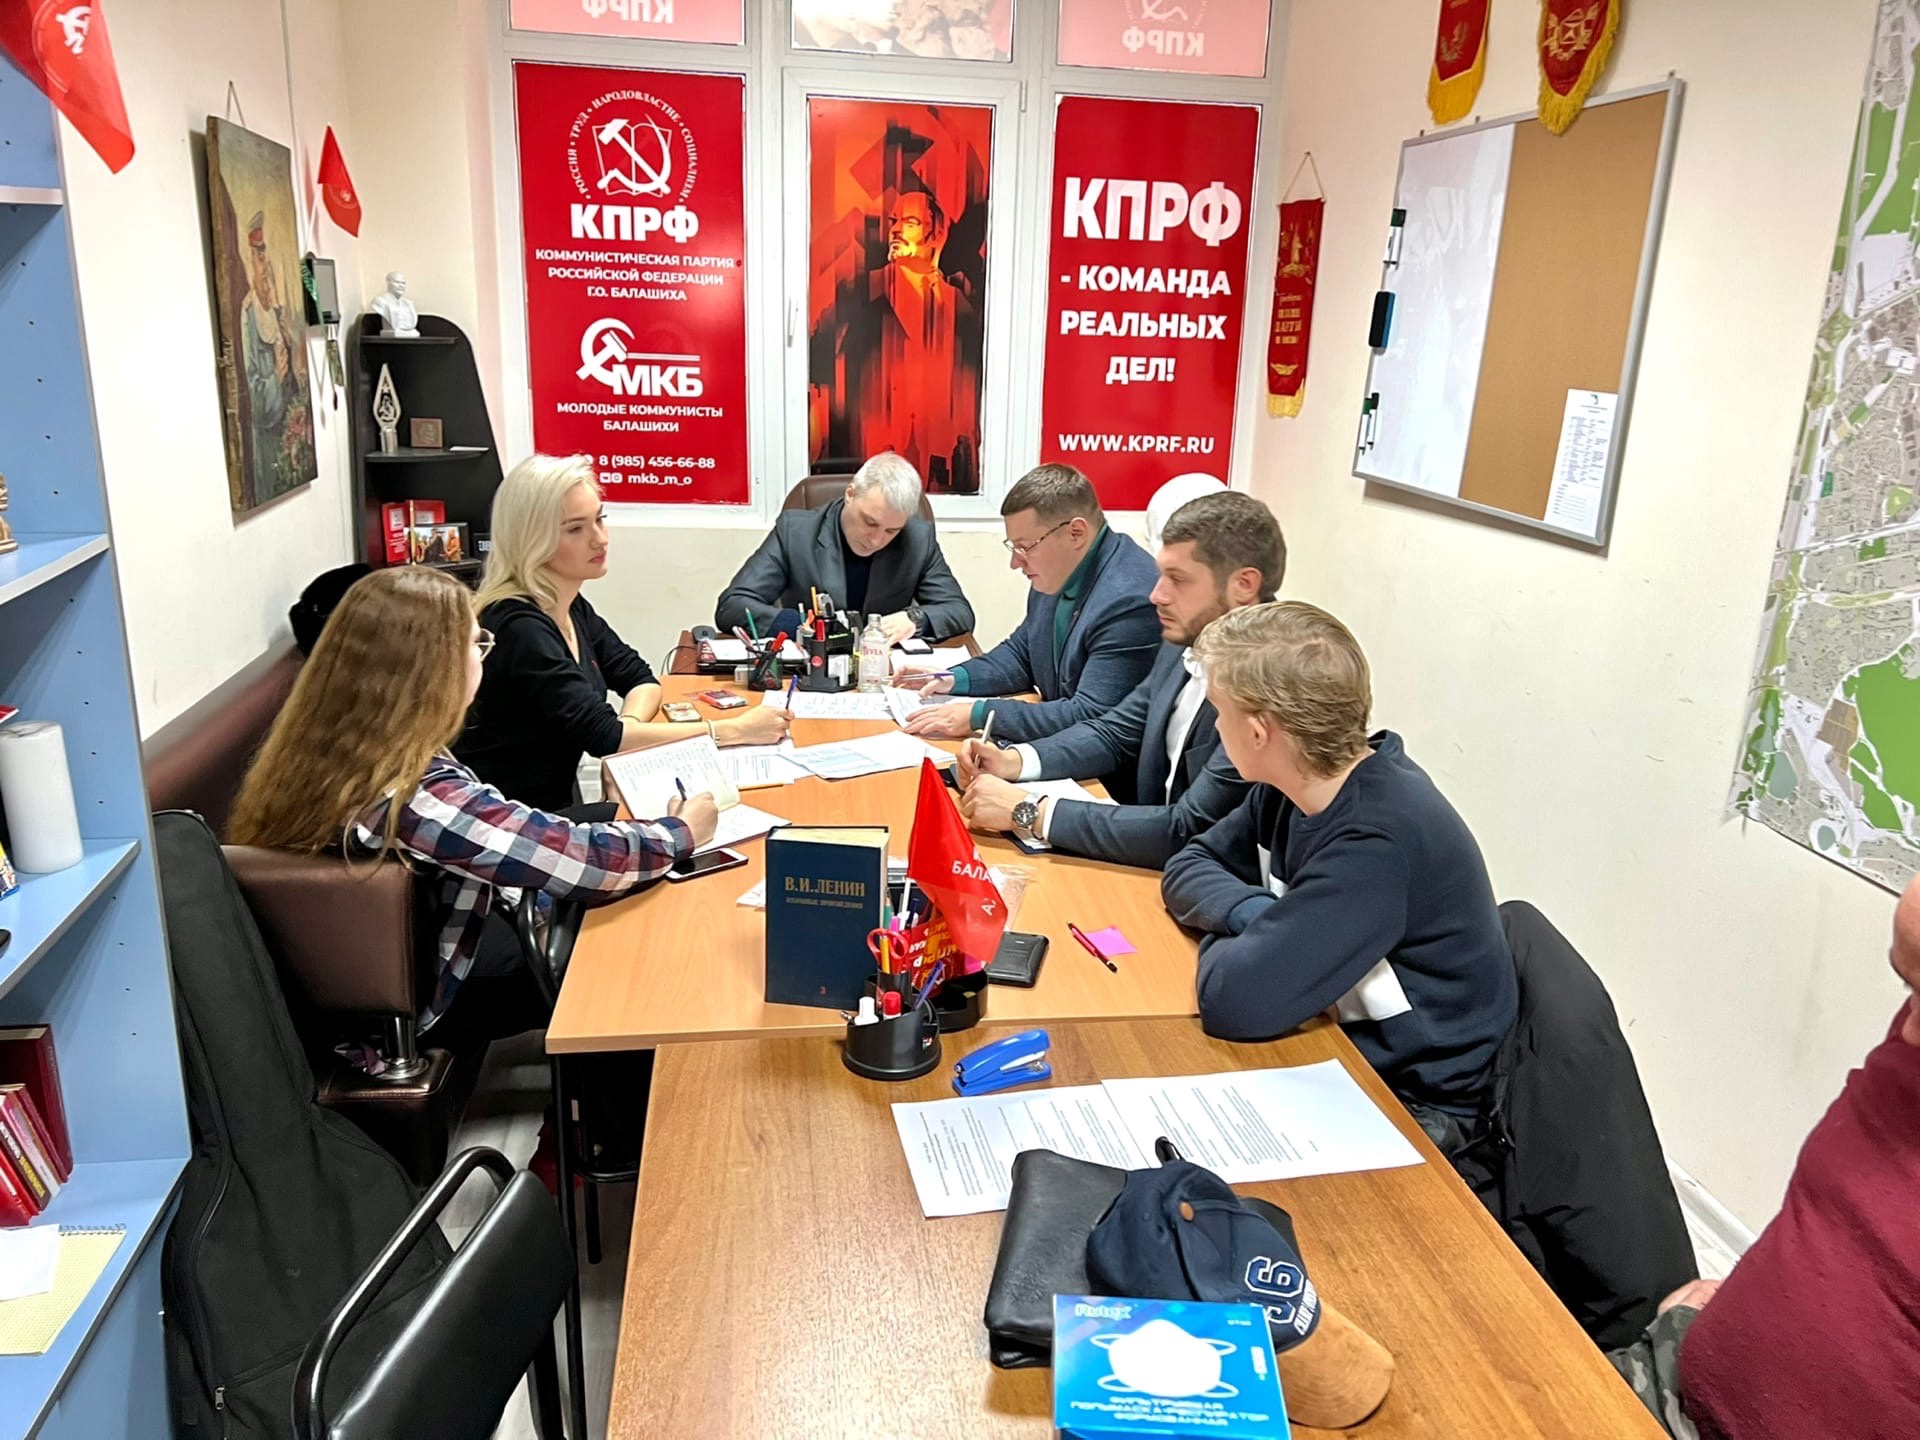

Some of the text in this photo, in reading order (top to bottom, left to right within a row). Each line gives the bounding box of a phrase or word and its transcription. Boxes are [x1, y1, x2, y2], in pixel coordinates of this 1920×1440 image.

[1063, 176, 1242, 247] КПРФ
[570, 203, 699, 244] КПРФ
[535, 249, 735, 269] КОММУНИСТИЧЕСКАЯ ПАРТИЯ
[548, 266, 724, 286] РОССИЙСКОЙ ФЕДЕРАЦИИ
[1078, 264, 1232, 299] КОМАНДА
[611, 287, 687, 300] БАЛАШИХА
[1060, 310, 1228, 340] РЕАЛЬНЫХ
[611, 363, 704, 397] МКБ
[1105, 356, 1176, 385] ДЕЛ!
[556, 402, 723, 418] МОЛОДЫЕ КОММУНИСТЫ
[603, 420, 680, 433] БАЛАШИХИ
[1058, 433, 1215, 454] WWW.KPRF.RU
[599, 455, 716, 469] 8 (985) 456-66-88
[627, 473, 693, 486] mkb_m_o
